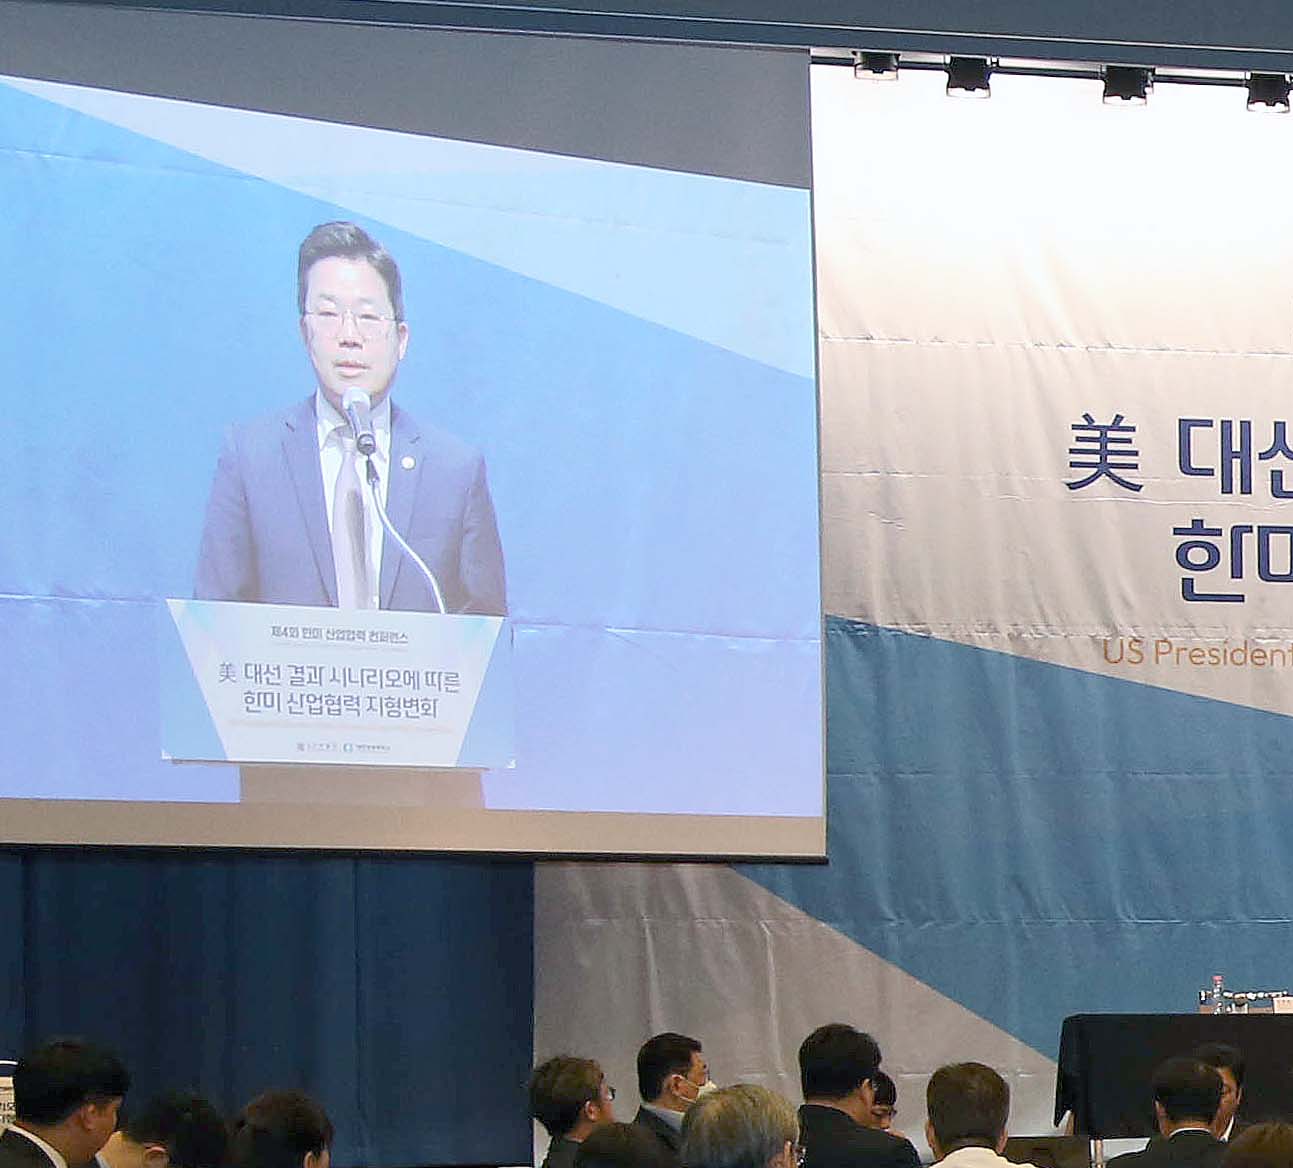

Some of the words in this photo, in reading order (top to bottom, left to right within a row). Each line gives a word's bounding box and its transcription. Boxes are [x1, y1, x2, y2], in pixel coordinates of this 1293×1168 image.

[1066, 414, 1143, 492] 美
[1103, 639, 1144, 664] US
[244, 663, 281, 686] 대선
[287, 664, 324, 687] 결과
[329, 666, 419, 690] 시나리오에
[425, 671, 461, 693] 따른
[243, 690, 281, 713] 한미
[287, 692, 361, 717] 산업협력
[366, 695, 439, 719] 지형변화
